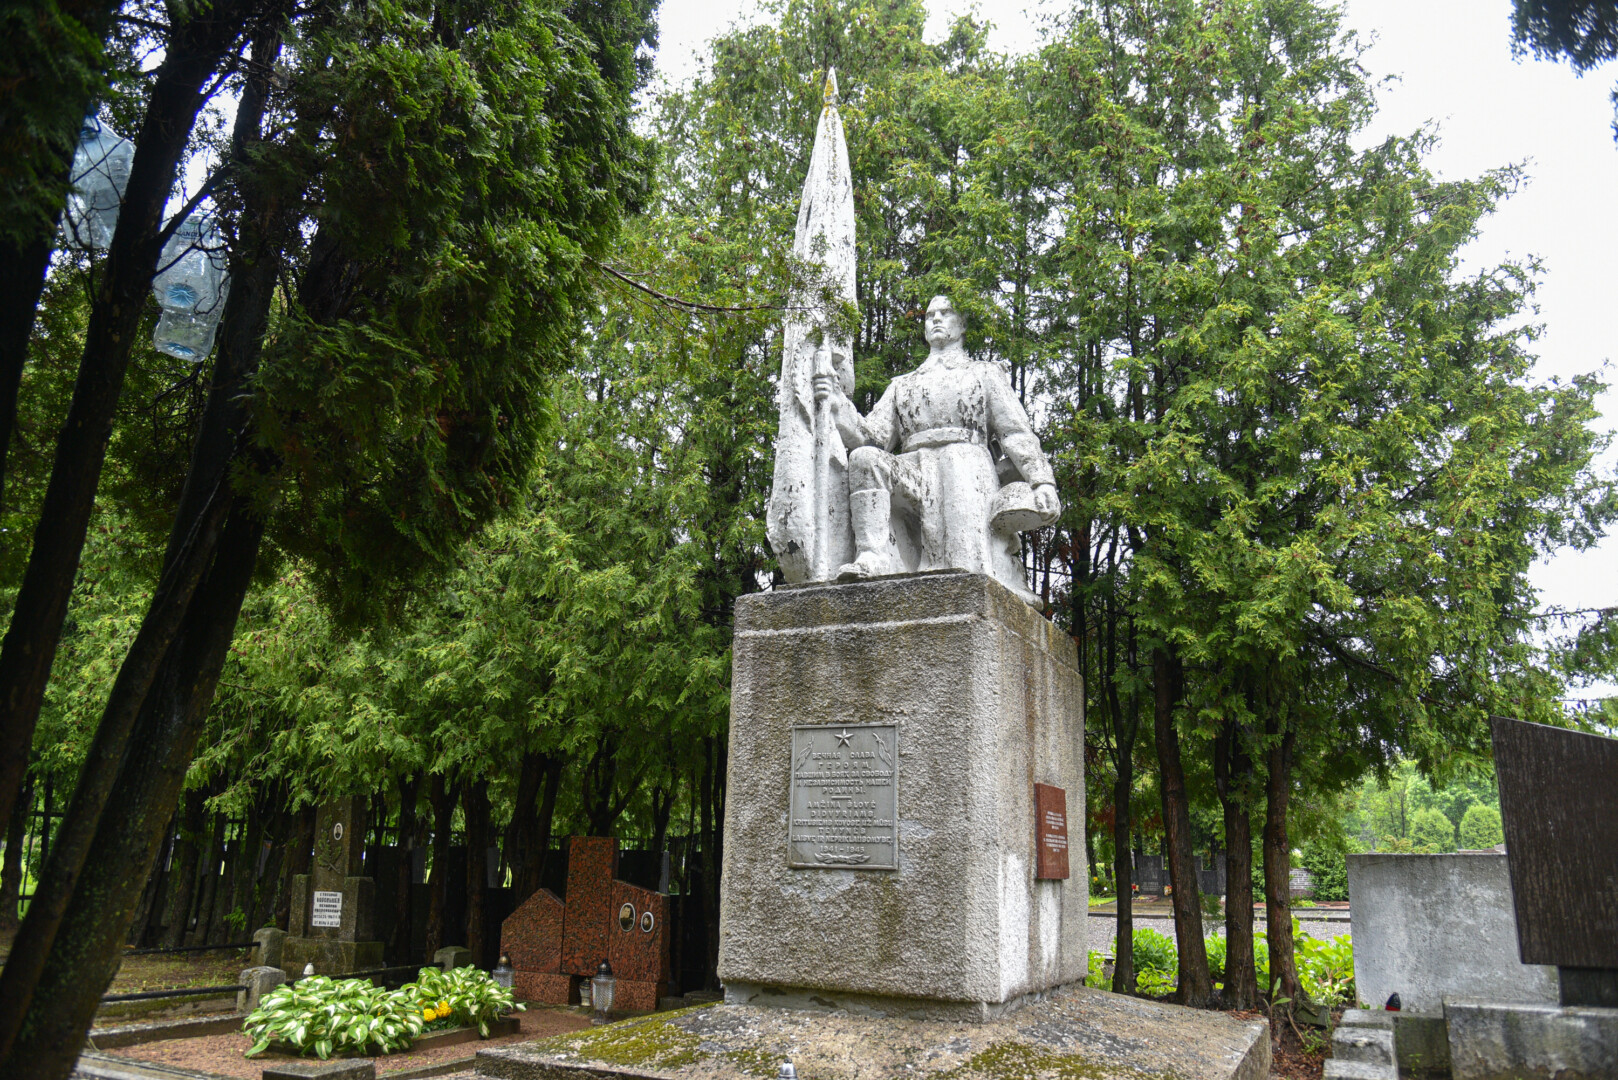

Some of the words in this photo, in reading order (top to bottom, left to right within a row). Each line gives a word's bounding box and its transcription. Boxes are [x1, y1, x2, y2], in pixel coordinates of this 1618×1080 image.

[812, 752, 841, 760] ВЕЧНАЯ
[849, 751, 876, 759] СЛАВА
[795, 771, 825, 779] ПАВШИМ
[832, 770, 850, 778] БОЯХ
[851, 770, 860, 778] ЗА
[861, 769, 894, 778] СВОБОДУ
[796, 779, 802, 787] И
[803, 778, 864, 787] НЕЗАВИСИМОСТЬ
[865, 777, 892, 787] НАШЕЙ
[834, 819, 861, 827] KOVOSE
[817, 835, 824, 843] IR
[820, 845, 838, 853] 1941
[846, 845, 865, 853] 1945
